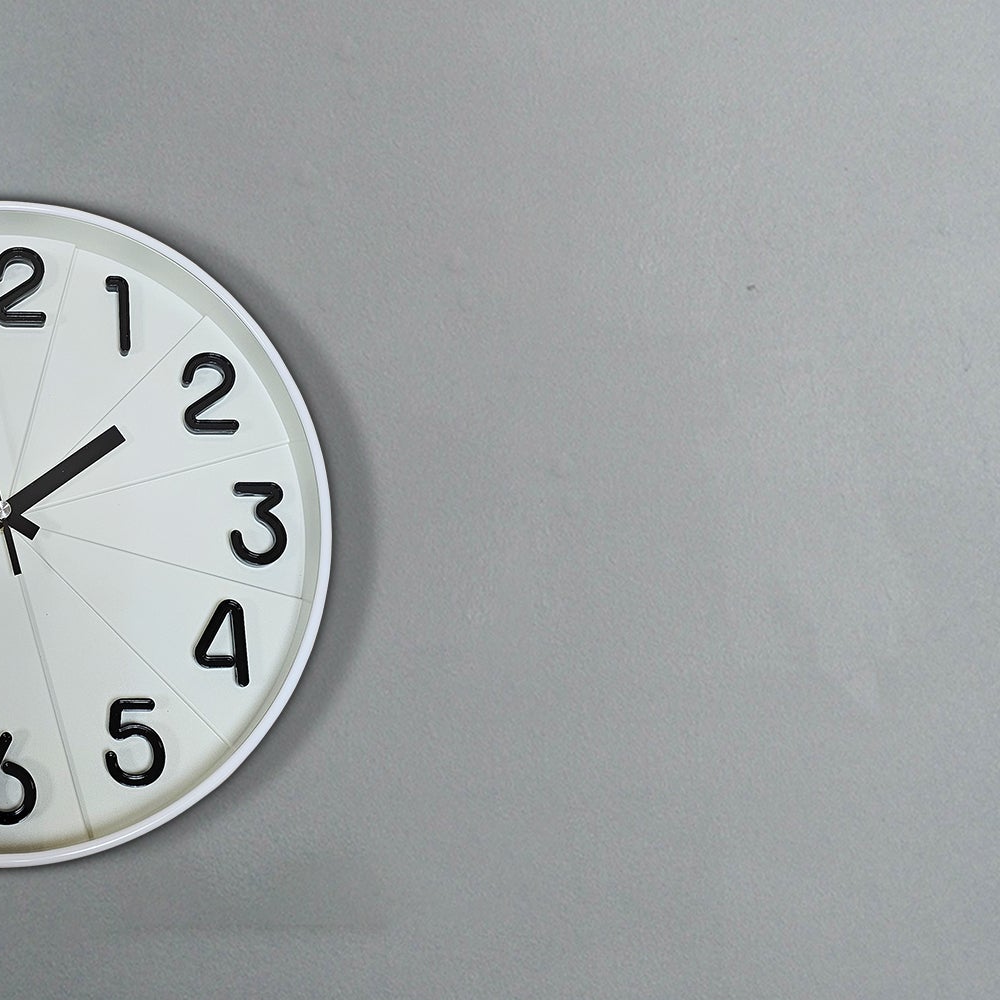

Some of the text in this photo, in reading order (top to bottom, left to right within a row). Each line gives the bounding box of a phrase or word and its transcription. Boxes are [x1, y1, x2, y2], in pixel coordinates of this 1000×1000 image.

[106, 276, 131, 356] 1
[181, 353, 240, 434] 2
[229, 482, 288, 567] 3
[194, 599, 251, 688] 4
[105, 698, 166, 788] 5
